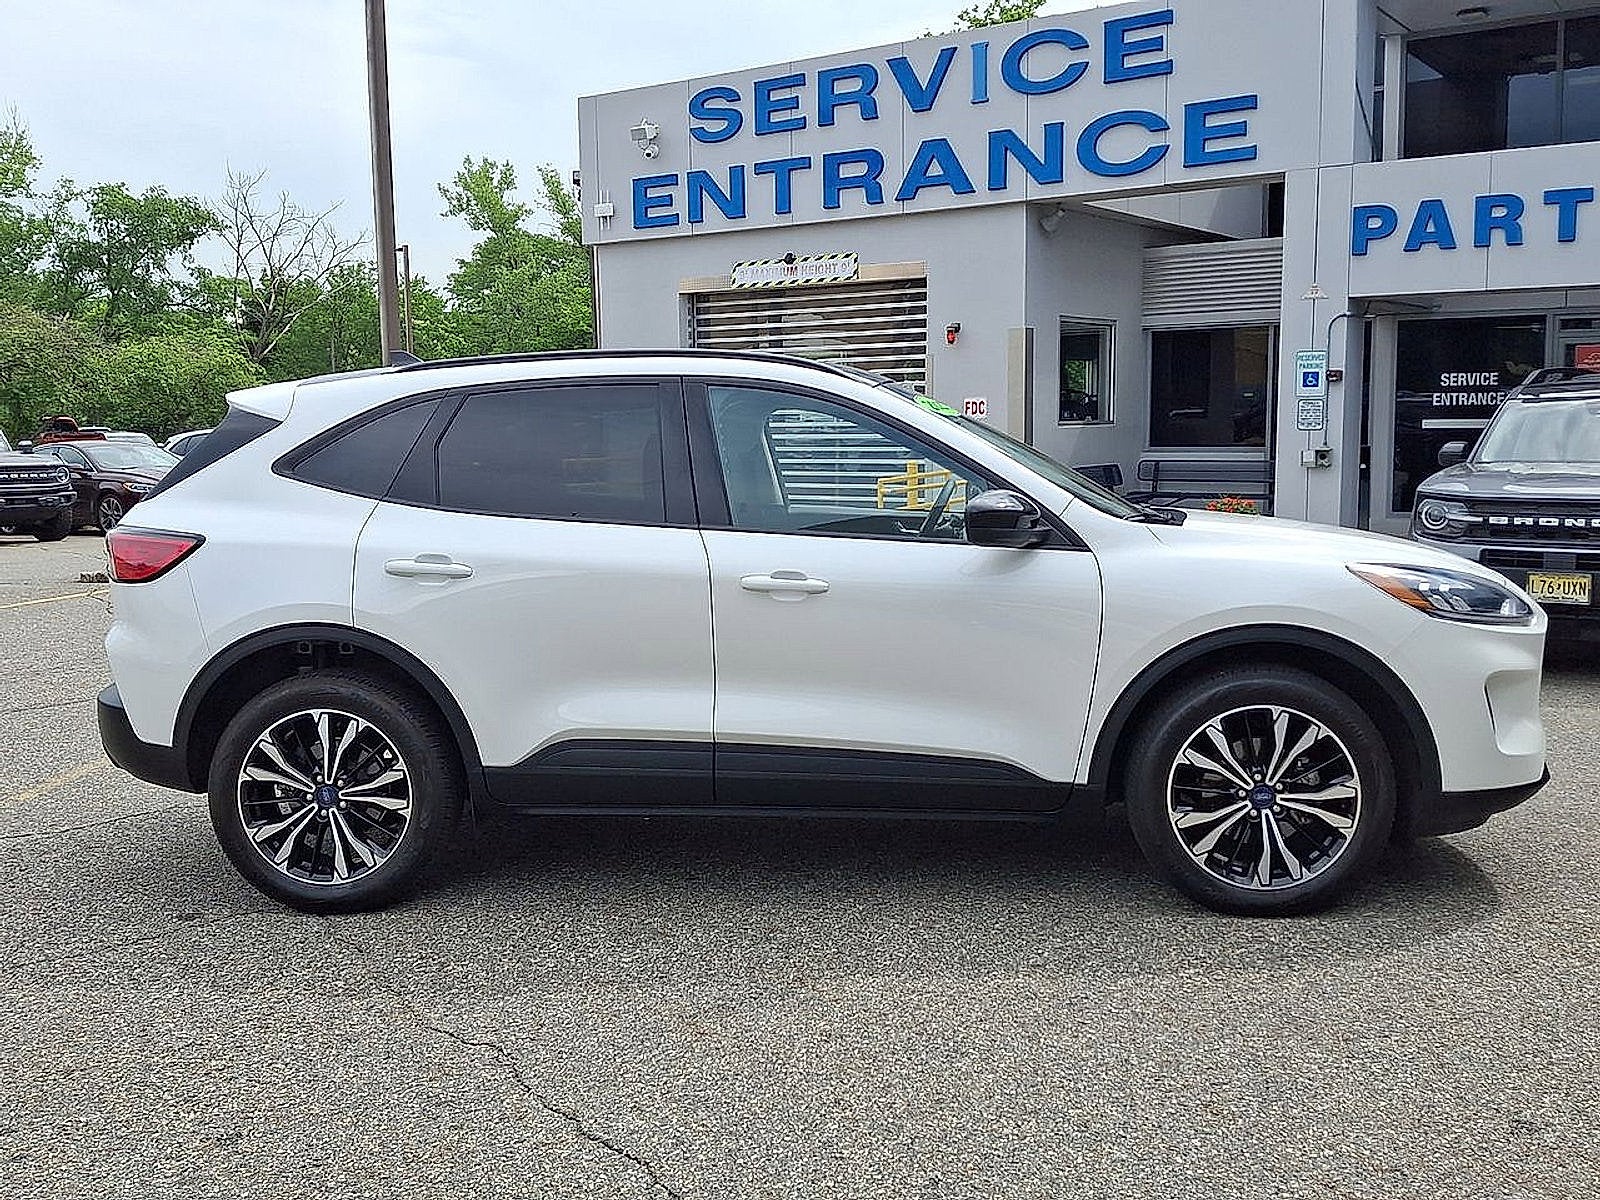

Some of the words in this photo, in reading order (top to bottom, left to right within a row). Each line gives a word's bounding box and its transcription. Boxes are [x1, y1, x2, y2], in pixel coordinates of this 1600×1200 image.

[688, 9, 1174, 143] SERVICE
[632, 95, 1258, 229] ENTRANCE
[1351, 187, 1596, 256] PART
[801, 262, 838, 275] HEIGHT
[1440, 372, 1499, 387] SERVICE
[1432, 391, 1504, 406] ENTRANCE
[964, 400, 986, 415] FDC
